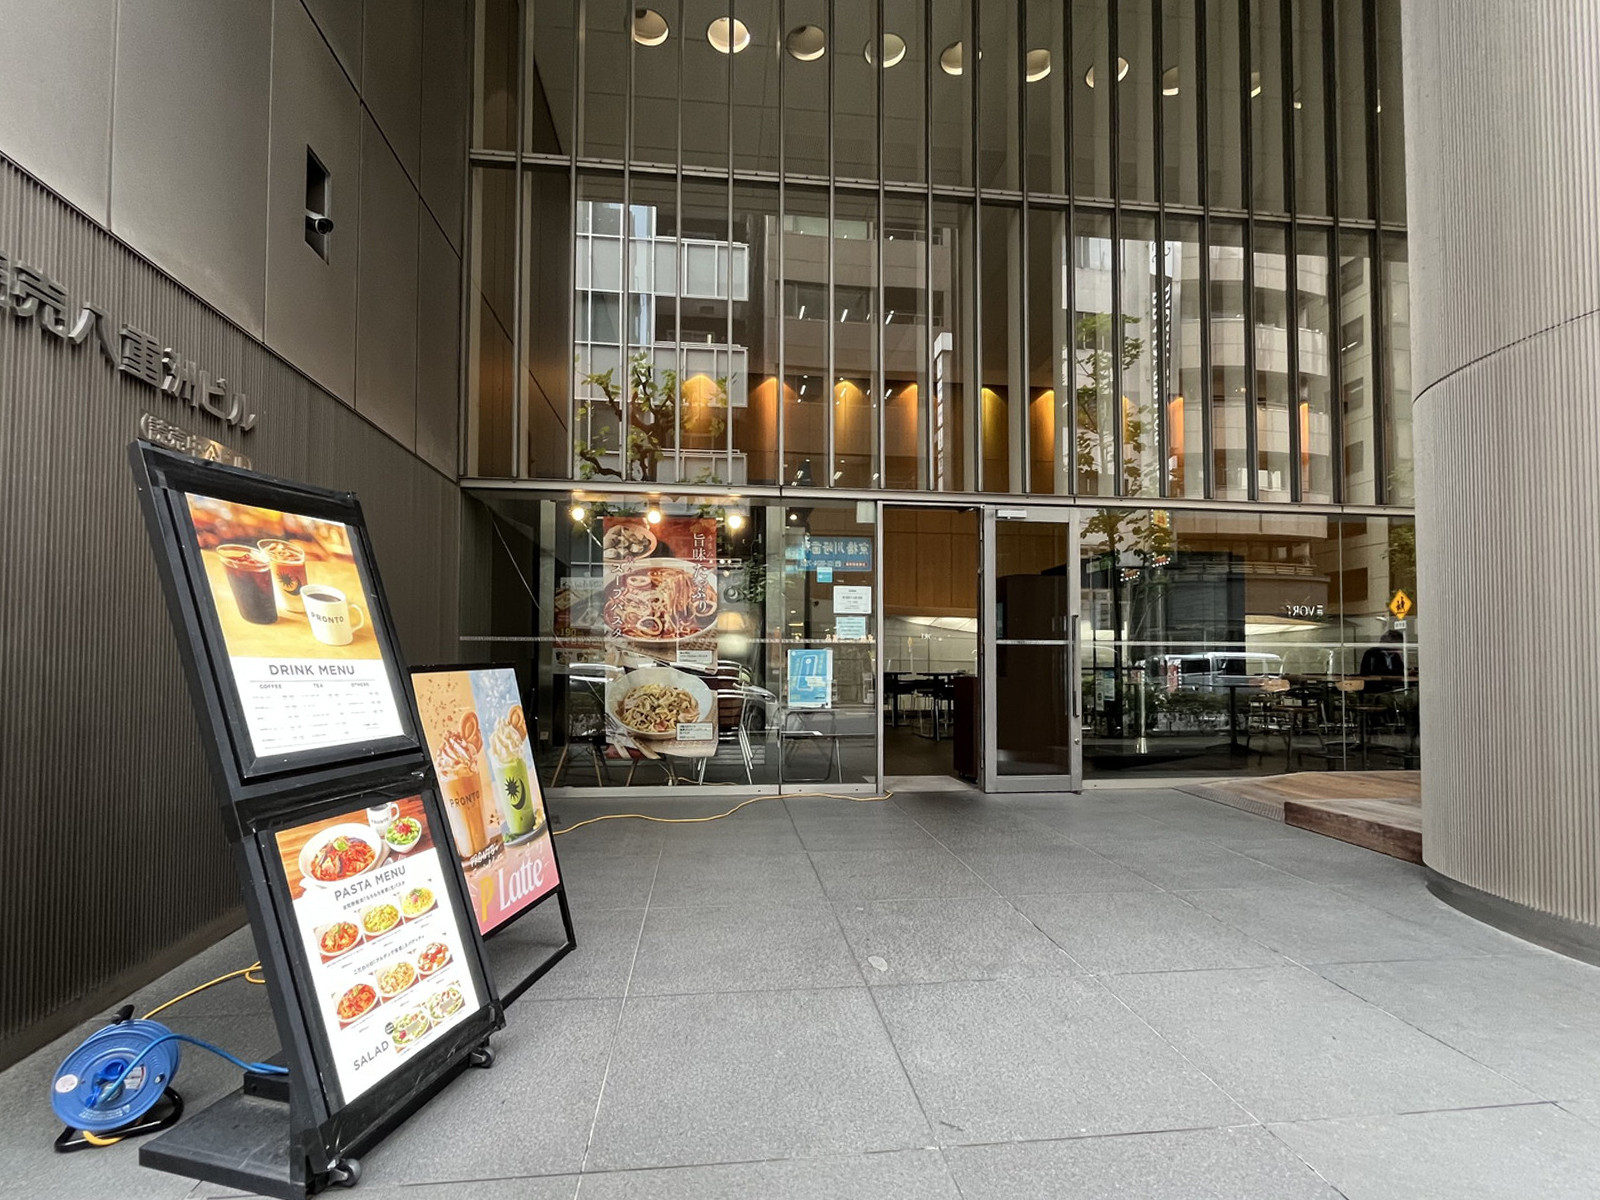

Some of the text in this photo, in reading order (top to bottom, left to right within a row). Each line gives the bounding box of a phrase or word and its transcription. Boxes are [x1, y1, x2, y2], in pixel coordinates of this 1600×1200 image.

[0, 251, 256, 432] 売八重洲ビル
[691, 532, 708, 613] 旨味たっぷり
[310, 612, 344, 623] PRONTO
[611, 563, 626, 639] スープパスタ
[269, 664, 355, 676] DRINK MENU
[450, 790, 480, 807] PRONTO
[334, 865, 406, 902] PASTA MENU
[498, 857, 545, 912] Latte
[352, 1040, 390, 1072] SALAD
